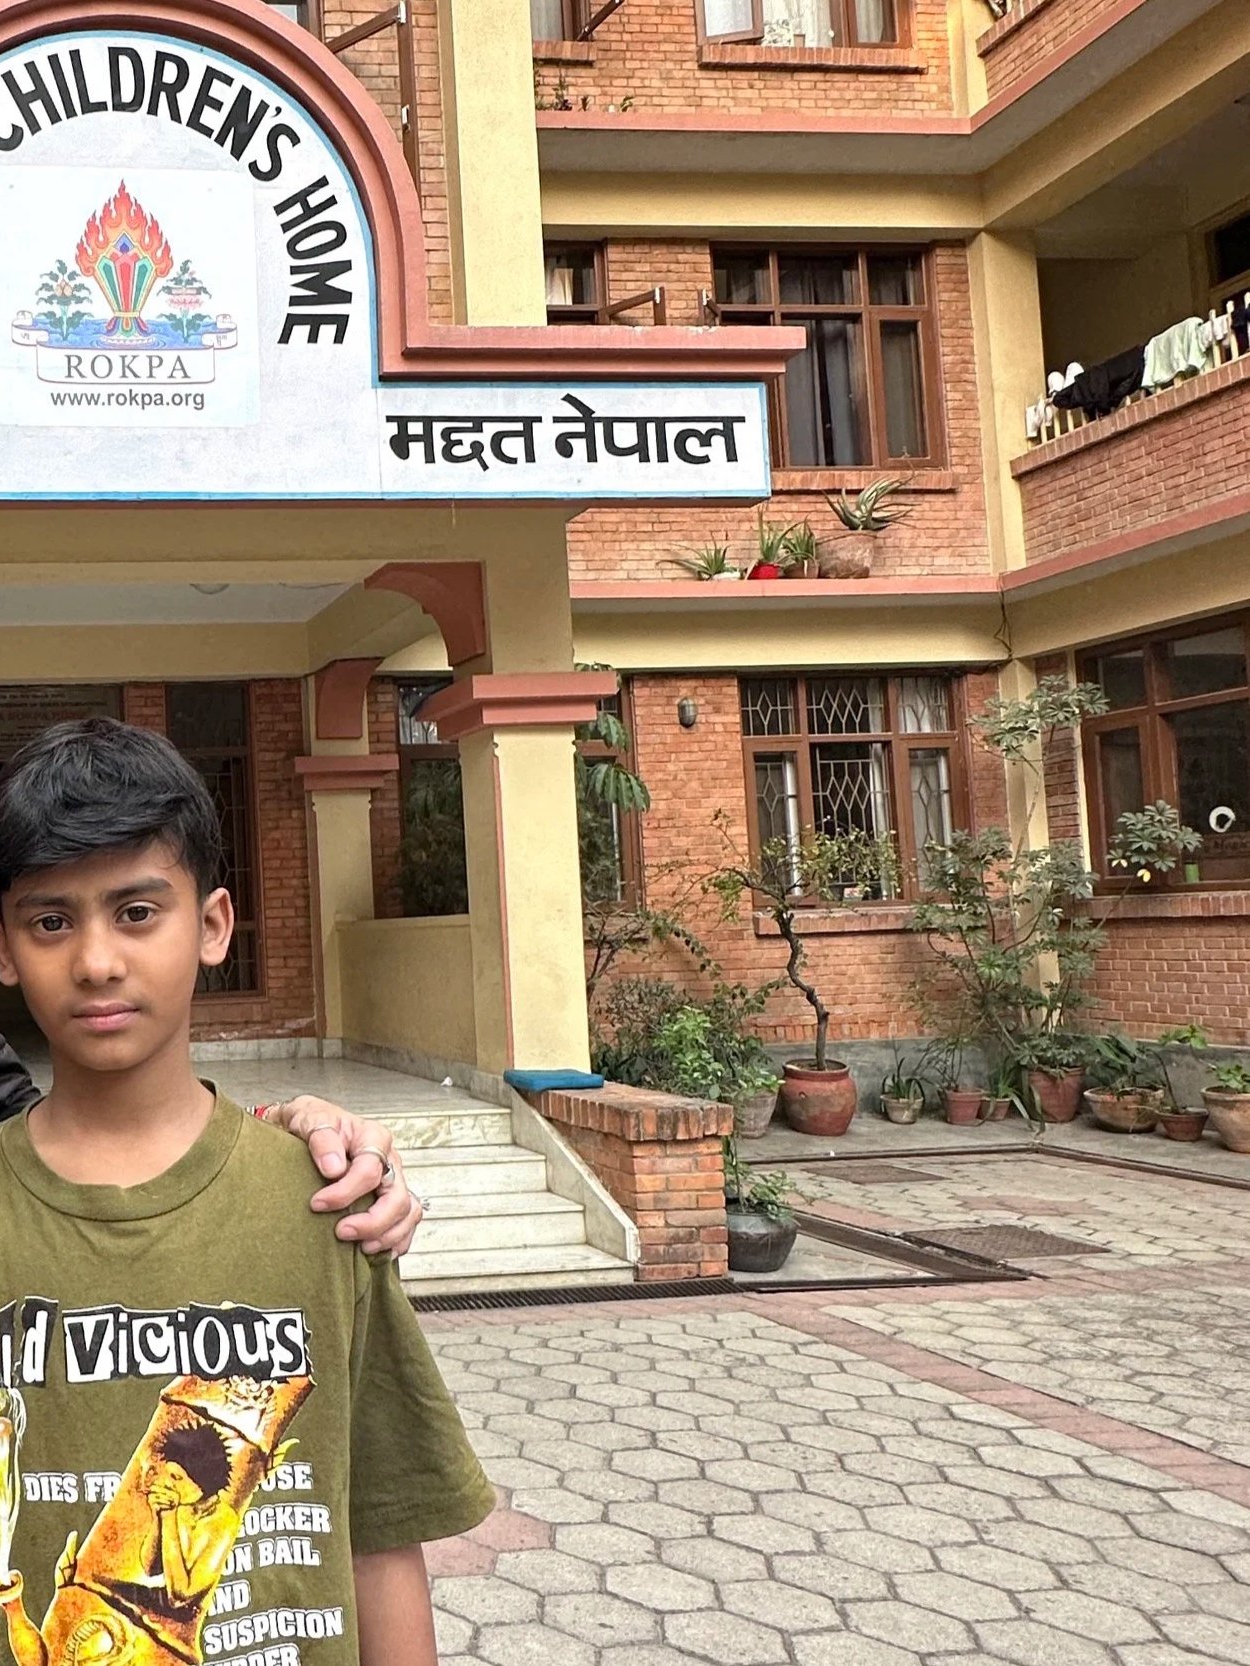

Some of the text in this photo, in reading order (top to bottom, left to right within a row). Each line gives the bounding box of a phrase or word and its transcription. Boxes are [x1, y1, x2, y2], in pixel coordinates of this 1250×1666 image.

[273, 175, 353, 345] HOME
[64, 354, 191, 379] ROKPA
[50, 389, 205, 411] www.rokpa.org
[385, 393, 746, 472] मद्दत नेपाल
[22, 1472, 79, 1504] DIES
[83, 1471, 123, 1503] FR
[236, 1503, 333, 1538] OCKER
[257, 1537, 322, 1568] BAIL
[203, 1607, 344, 1655] SUSPICION
